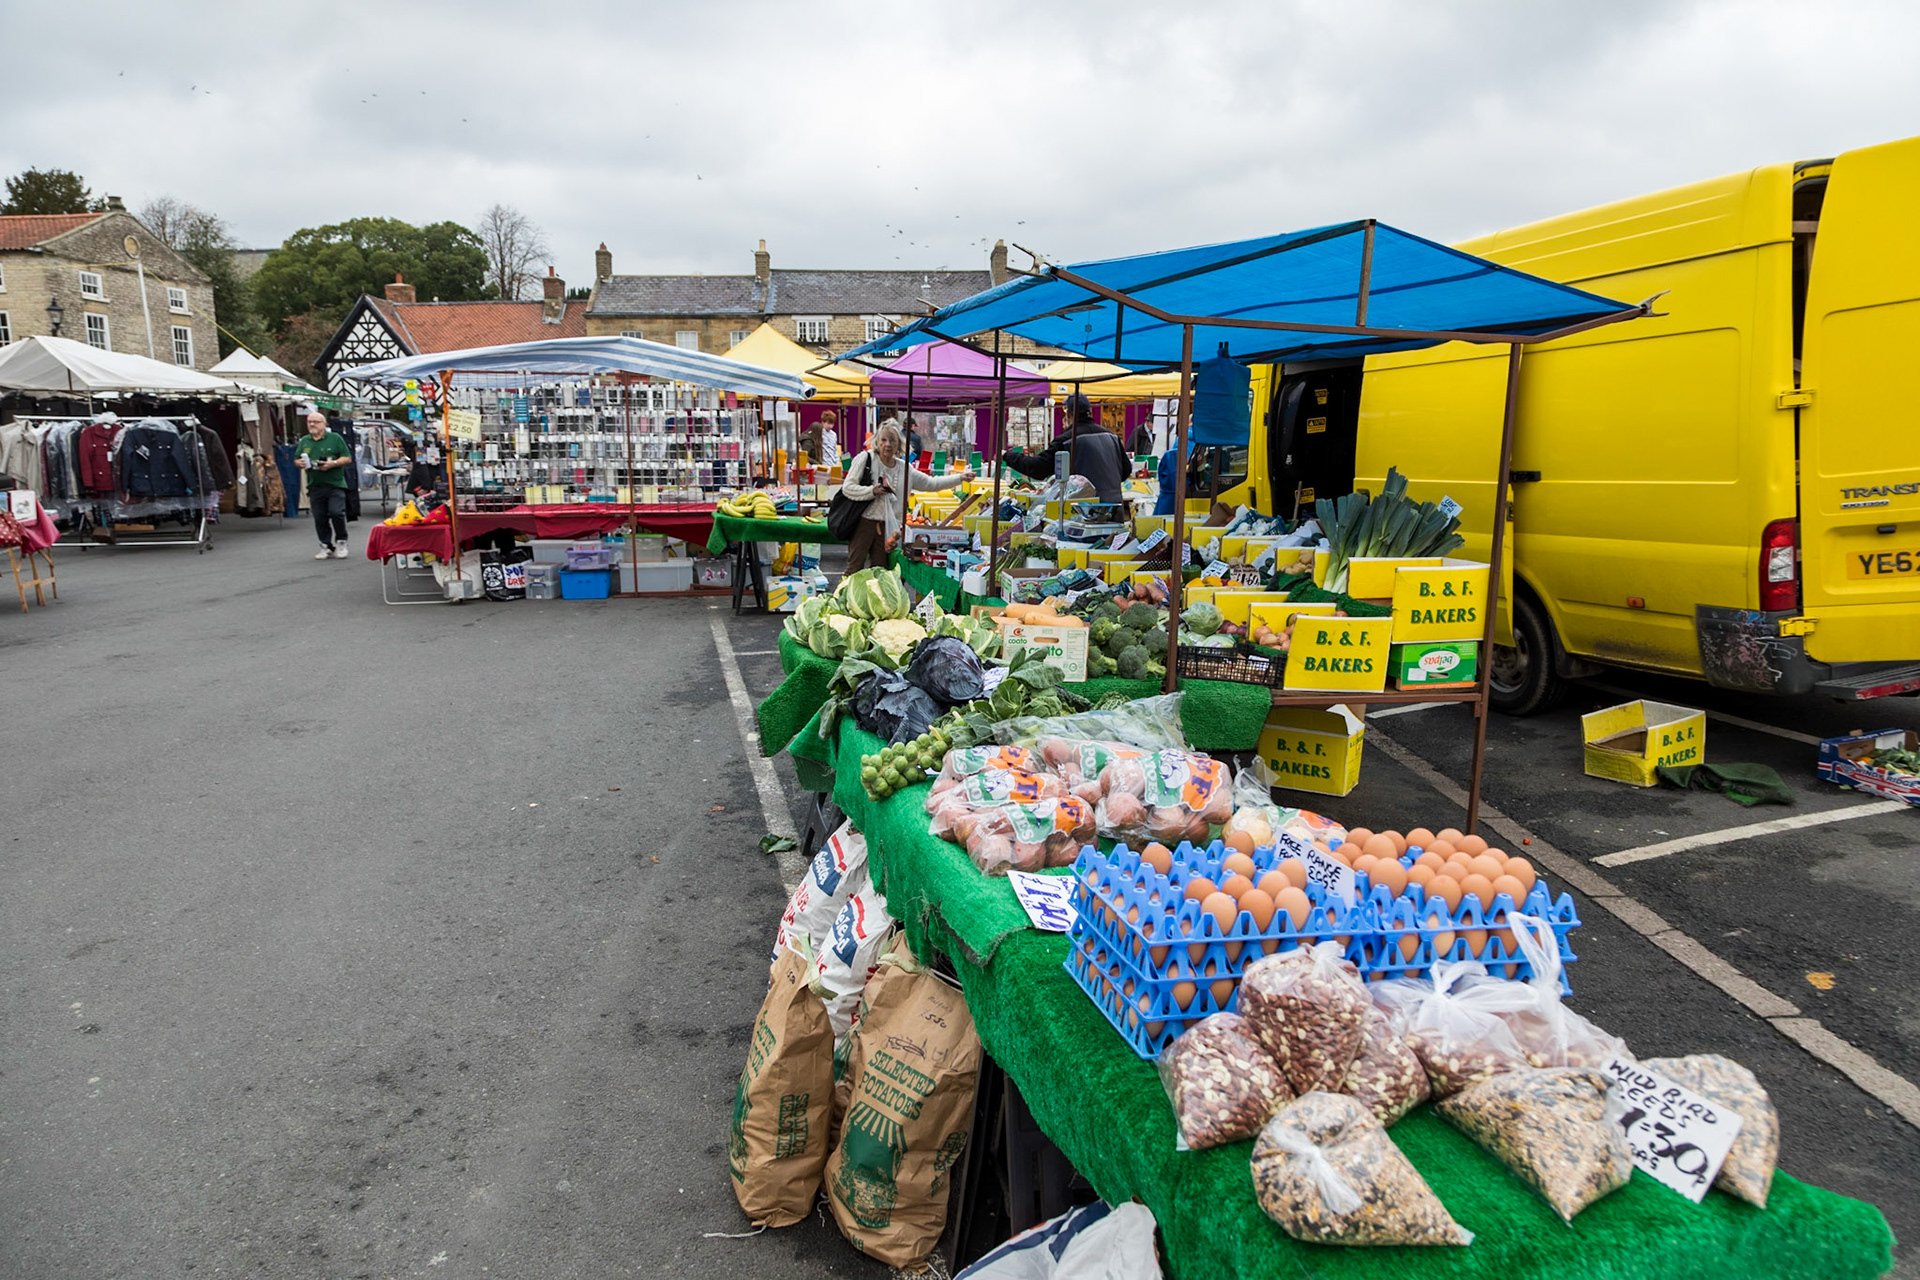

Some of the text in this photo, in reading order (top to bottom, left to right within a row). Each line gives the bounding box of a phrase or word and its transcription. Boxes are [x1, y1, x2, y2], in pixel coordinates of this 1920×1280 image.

[1840, 483, 1920, 498] TRANSI
[1420, 581, 1472, 597] B. & F.
[1410, 607, 1476, 624] BAKERS
[1316, 630, 1371, 646] B. & F.
[1304, 656, 1373, 673] BAKERS
[1277, 738, 1326, 756] B. & F.
[1663, 728, 1694, 746] B. & F.
[1658, 746, 1696, 767] BAKERS
[1270, 759, 1330, 779] BAKERS
[1191, 775, 1213, 799] F
[1280, 833, 1342, 879] FREE RANGE
[868, 1050, 937, 1098] SELECTED
[858, 1070, 924, 1120] POTATOES
[1610, 1060, 1718, 1124] WILD BIRD
[1618, 1078, 1691, 1128] SEEDS
[777, 1094, 794, 1159] SELECTED
[792, 1092, 810, 1157] POTATOES
